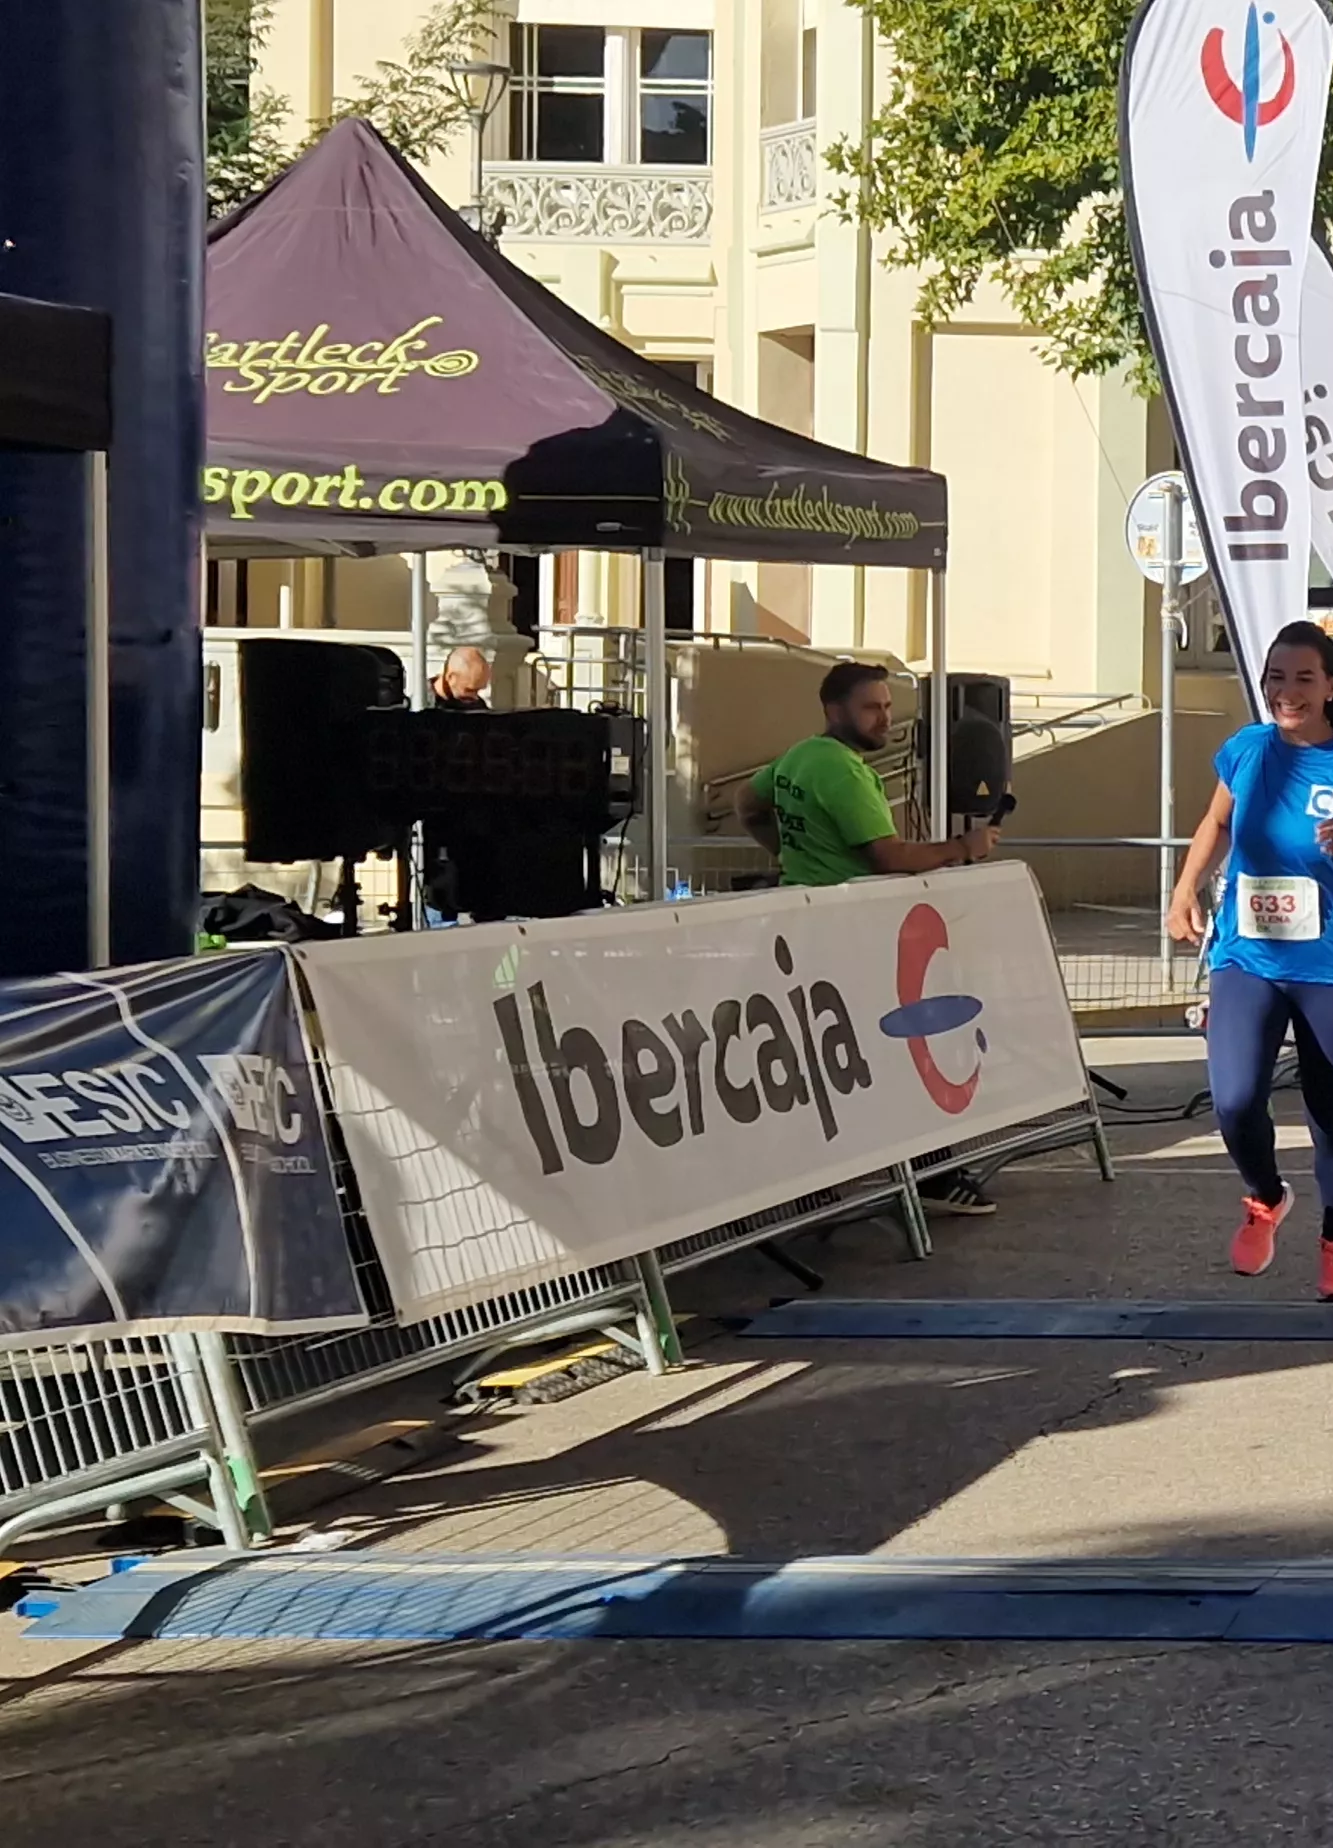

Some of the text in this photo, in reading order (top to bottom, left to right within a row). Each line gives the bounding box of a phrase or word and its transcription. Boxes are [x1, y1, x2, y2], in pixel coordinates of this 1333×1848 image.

[223, 356, 410, 404] Sport
[1208, 189, 1293, 562] Ibercaja
[707, 481, 919, 549] www.fartlecksport.com
[1250, 894, 1297, 914] 633
[493, 934, 873, 1176] Ibercaja
[9, 1062, 192, 1143] ESIC
